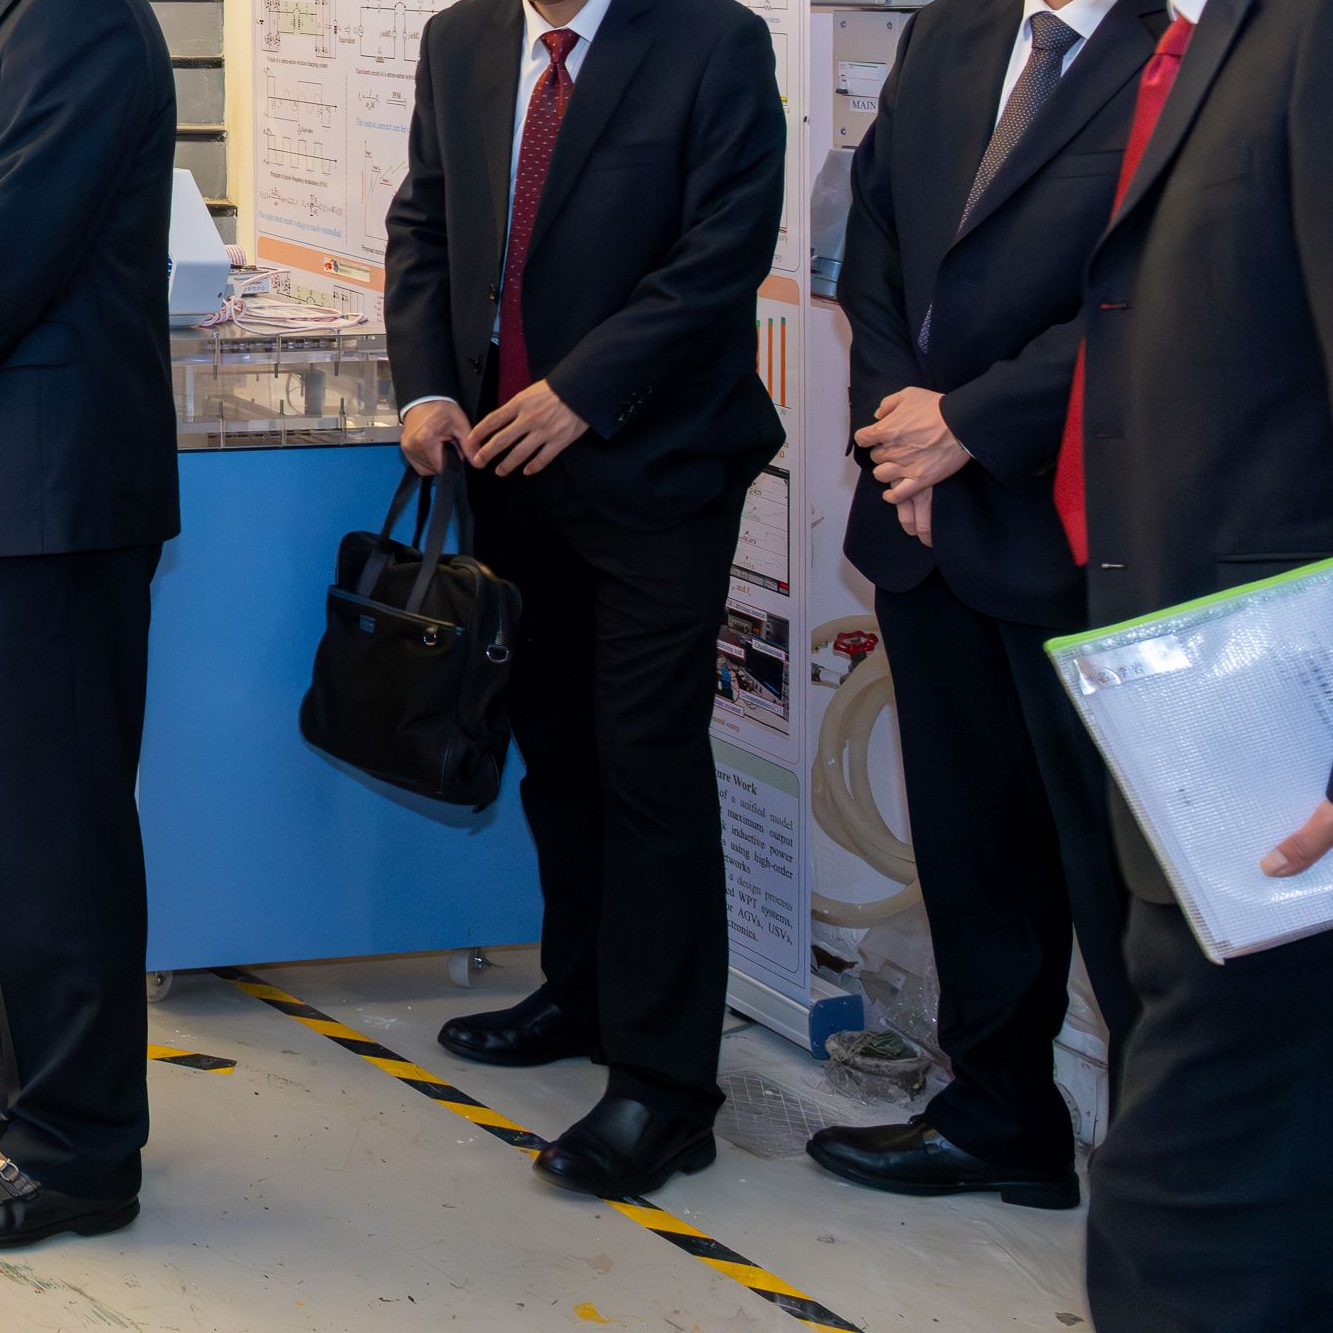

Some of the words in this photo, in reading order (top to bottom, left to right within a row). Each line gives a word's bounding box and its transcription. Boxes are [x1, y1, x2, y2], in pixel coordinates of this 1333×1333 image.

[733, 774, 758, 795] Work
[720, 789, 728, 800] of
[740, 800, 765, 817] unified
[770, 814, 793, 830] model
[728, 810, 764, 833] maximum
[769, 830, 793, 847] output
[732, 825, 765, 849] inductive
[770, 846, 793, 863] power
[731, 843, 750, 860] using
[754, 851, 793, 879] high-order
[737, 877, 761, 895] design
[765, 891, 793, 911] process
[739, 891, 758, 908] WPT
[761, 903, 793, 929] systems,
[738, 908, 763, 930] AGVs,
[768, 922, 793, 945] USVs,
